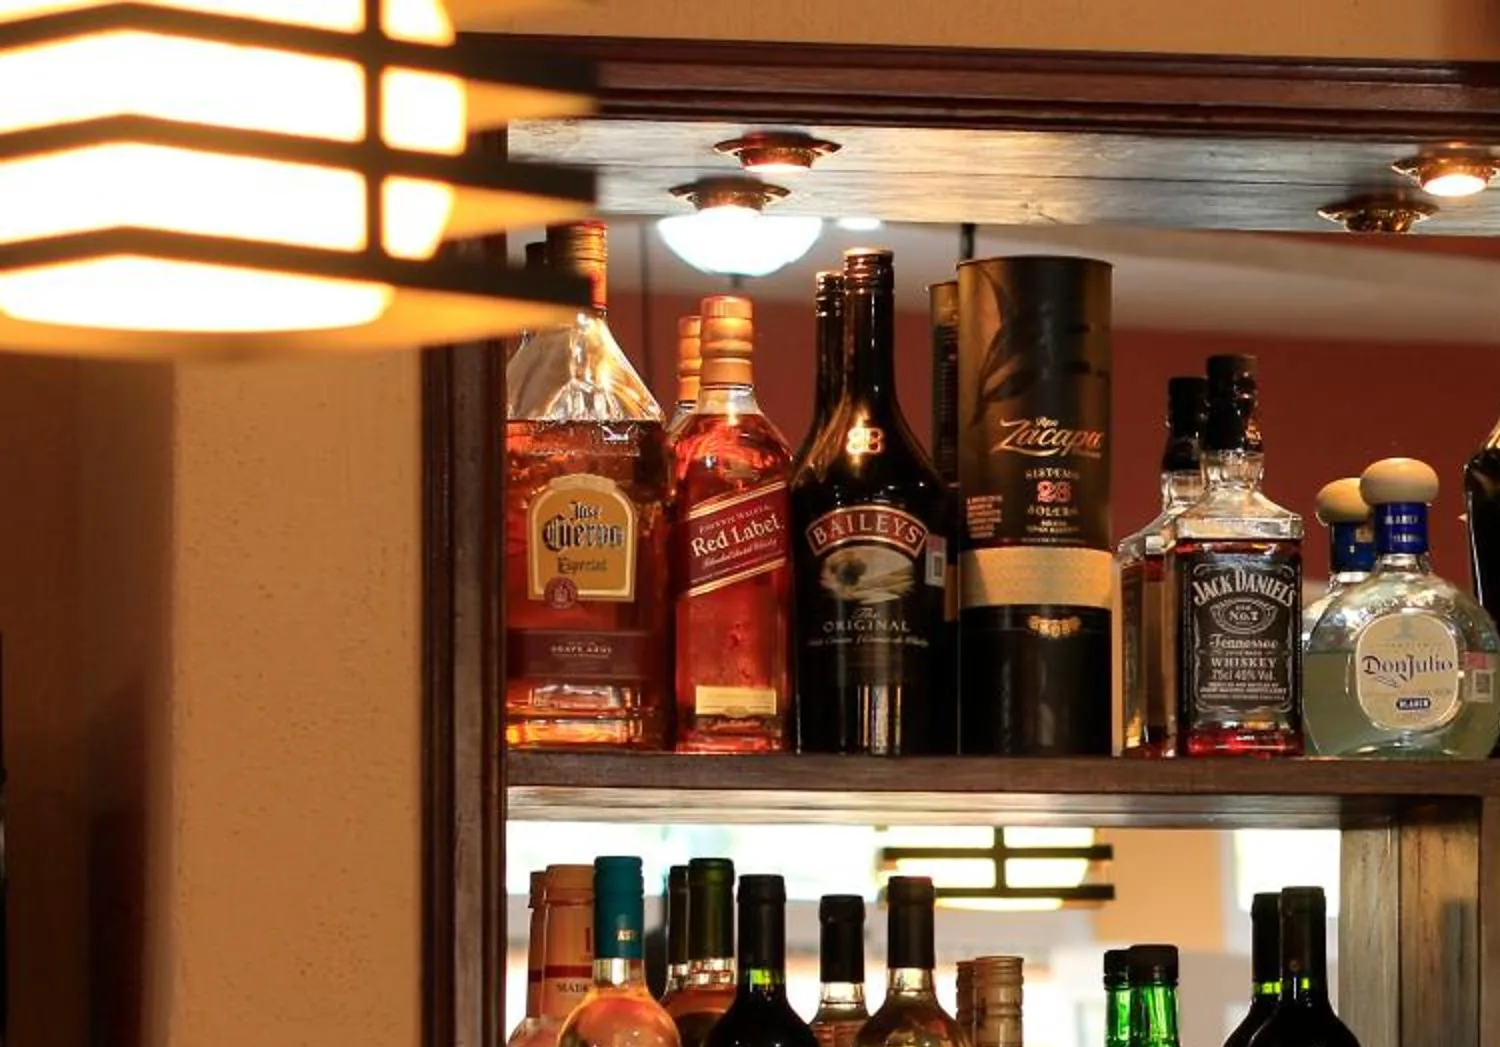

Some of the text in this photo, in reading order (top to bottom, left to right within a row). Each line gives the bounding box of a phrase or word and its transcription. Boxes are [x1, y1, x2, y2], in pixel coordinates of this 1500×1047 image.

[990, 419, 1104, 456] Zacapa
[813, 513, 923, 546] BAILEYS
[691, 530, 729, 557] Red
[1192, 574, 1233, 606] JACK
[823, 620, 912, 634] ORIGINAL
[1209, 633, 1279, 649] Tennessee
[1211, 657, 1277, 669] WHISKEY
